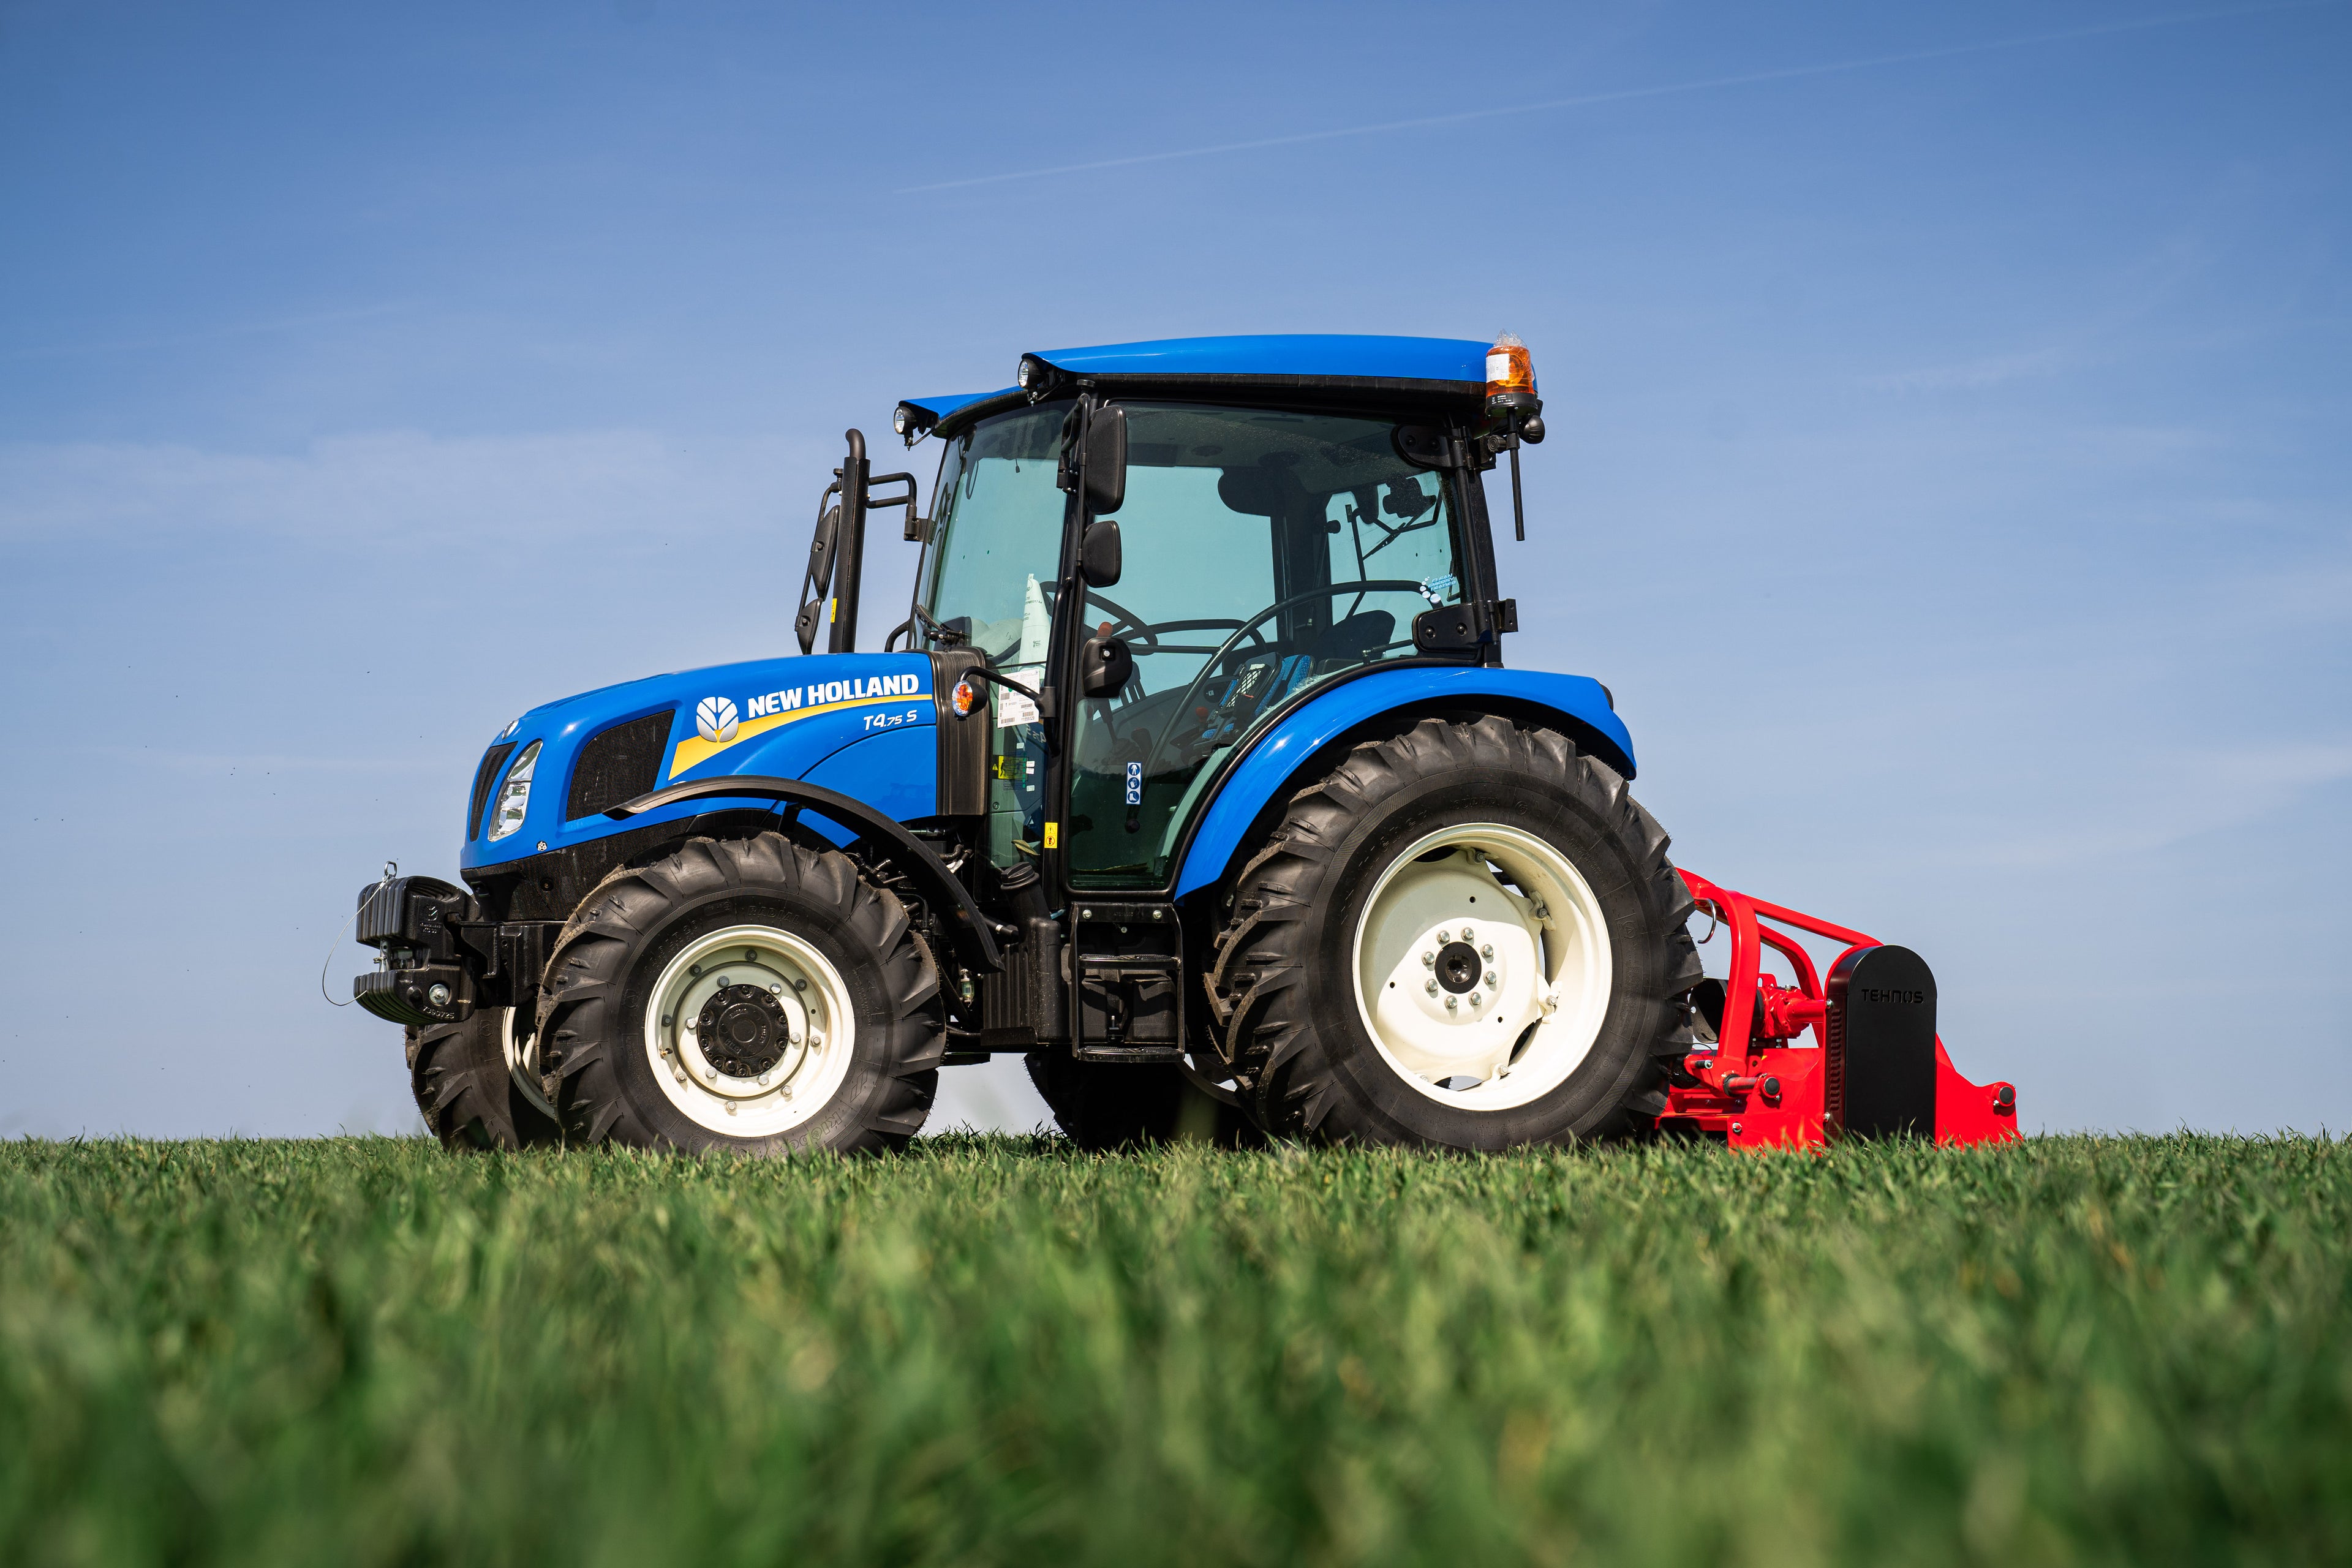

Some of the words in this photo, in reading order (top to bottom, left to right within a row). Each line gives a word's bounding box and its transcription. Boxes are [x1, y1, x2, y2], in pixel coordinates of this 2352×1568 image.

[1432, 573, 1452, 582] CLEAN
[1431, 581, 1456, 592] LEADER
[748, 687, 802, 718] NEW
[808, 674, 919, 706] HOLLAND
[864, 714, 902, 731] T4.75
[907, 710, 917, 723] S
[748, 905, 799, 925] RADIAL
[1861, 989, 1924, 1004] TEHNOS
[1569, 1091, 1584, 1107] 30
